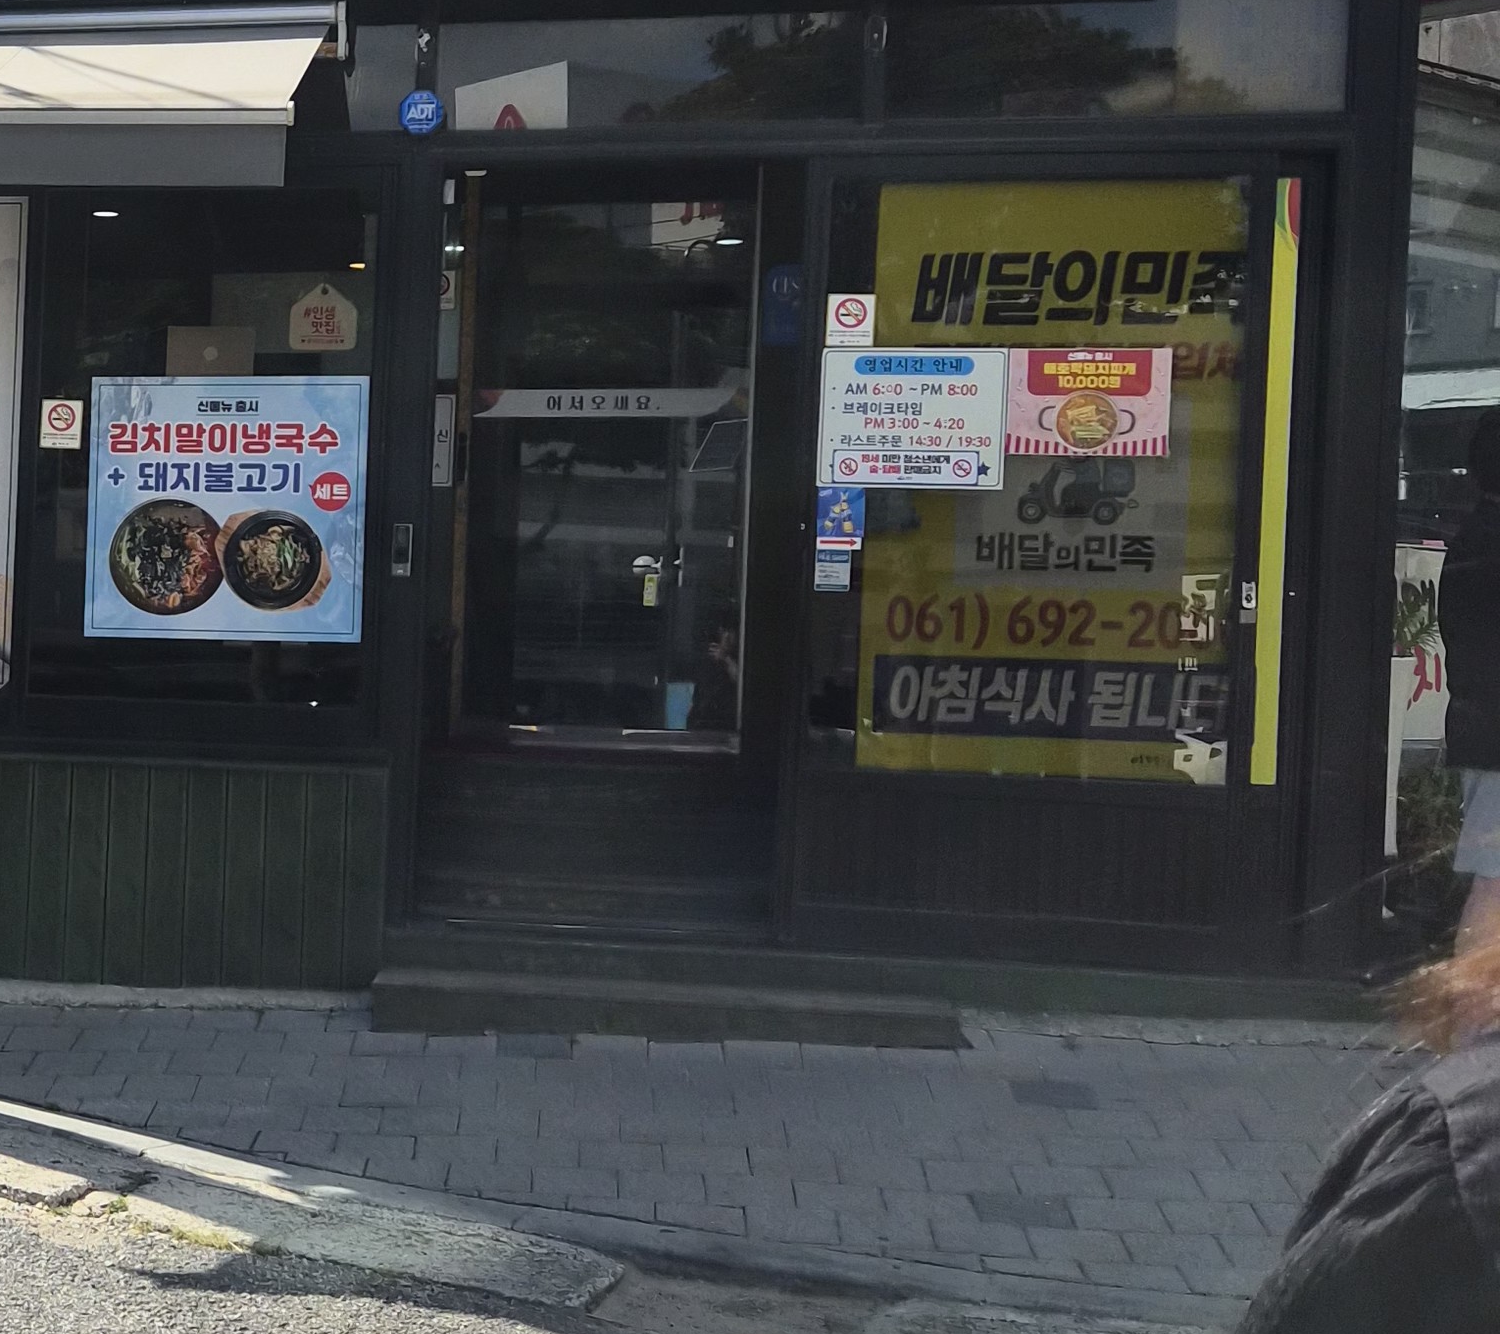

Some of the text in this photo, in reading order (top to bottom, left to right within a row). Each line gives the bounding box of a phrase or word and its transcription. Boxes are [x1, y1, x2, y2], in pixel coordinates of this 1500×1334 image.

[406, 103, 436, 120] ADT
[311, 321, 336, 335] 맛집
[864, 358, 964, 373] 영업시간 안내
[844, 383, 868, 395] AM
[920, 383, 943, 396] PM
[947, 384, 978, 396] 8:00
[842, 402, 923, 416] 브레이크타임
[864, 418, 885, 429] PM
[888, 418, 919, 429] 3:00
[933, 418, 965, 430] 4:20
[108, 422, 340, 455] 김치말이냉국수
[840, 434, 903, 448] 라스트주문
[908, 436, 942, 448] 14:30
[958, 436, 991, 448] 19:30
[882, 454, 901, 463] 미만
[137, 461, 301, 494] 돼지불고기
[313, 481, 350, 501] 세트
[976, 532, 1156, 573] 배달의민족
[887, 593, 991, 650] 061)
[1007, 595, 1228, 650] 692-20
[888, 664, 1076, 727] 아침식사
